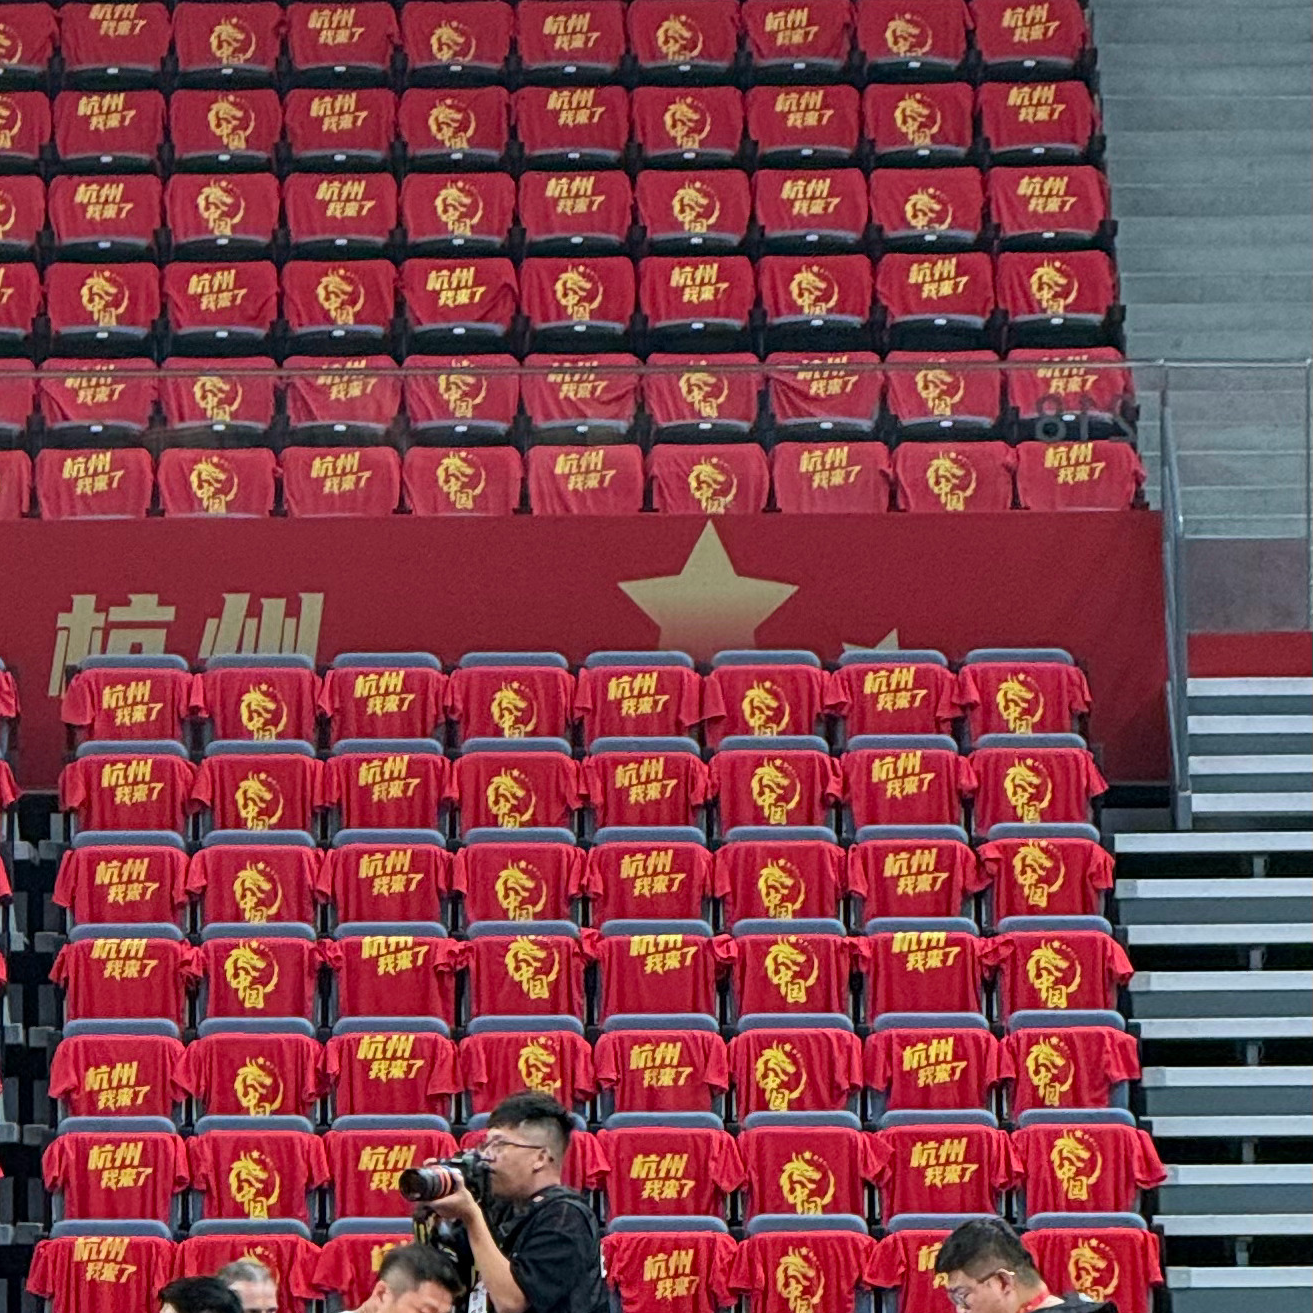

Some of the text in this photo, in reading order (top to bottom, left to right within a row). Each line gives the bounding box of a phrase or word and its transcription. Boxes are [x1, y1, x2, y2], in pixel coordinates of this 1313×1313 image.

[354, 670, 404, 697] 杭州
[608, 672, 657, 700] 杭州
[864, 666, 915, 694] 杭州
[102, 680, 150, 709] 杭州
[102, 758, 152, 787] 杭州
[359, 756, 409, 786] 杭州
[616, 757, 664, 787] 杭州
[872, 750, 922, 782] 杭州
[96, 859, 149, 884] 杭州
[359, 850, 412, 878] 杭州
[620, 850, 673, 878] 杭州
[884, 848, 937, 876] 杭州
[357, 1034, 414, 1059] 杭州
[630, 1042, 681, 1069] 杭州
[903, 1037, 953, 1070] 杭州
[85, 1062, 137, 1090] 杭州
[88, 1142, 142, 1170] 杭州
[358, 1145, 416, 1171] 杭州
[630, 1154, 688, 1179] 杭州
[910, 1138, 966, 1167] 杭州
[74, 1236, 130, 1261] 杭州
